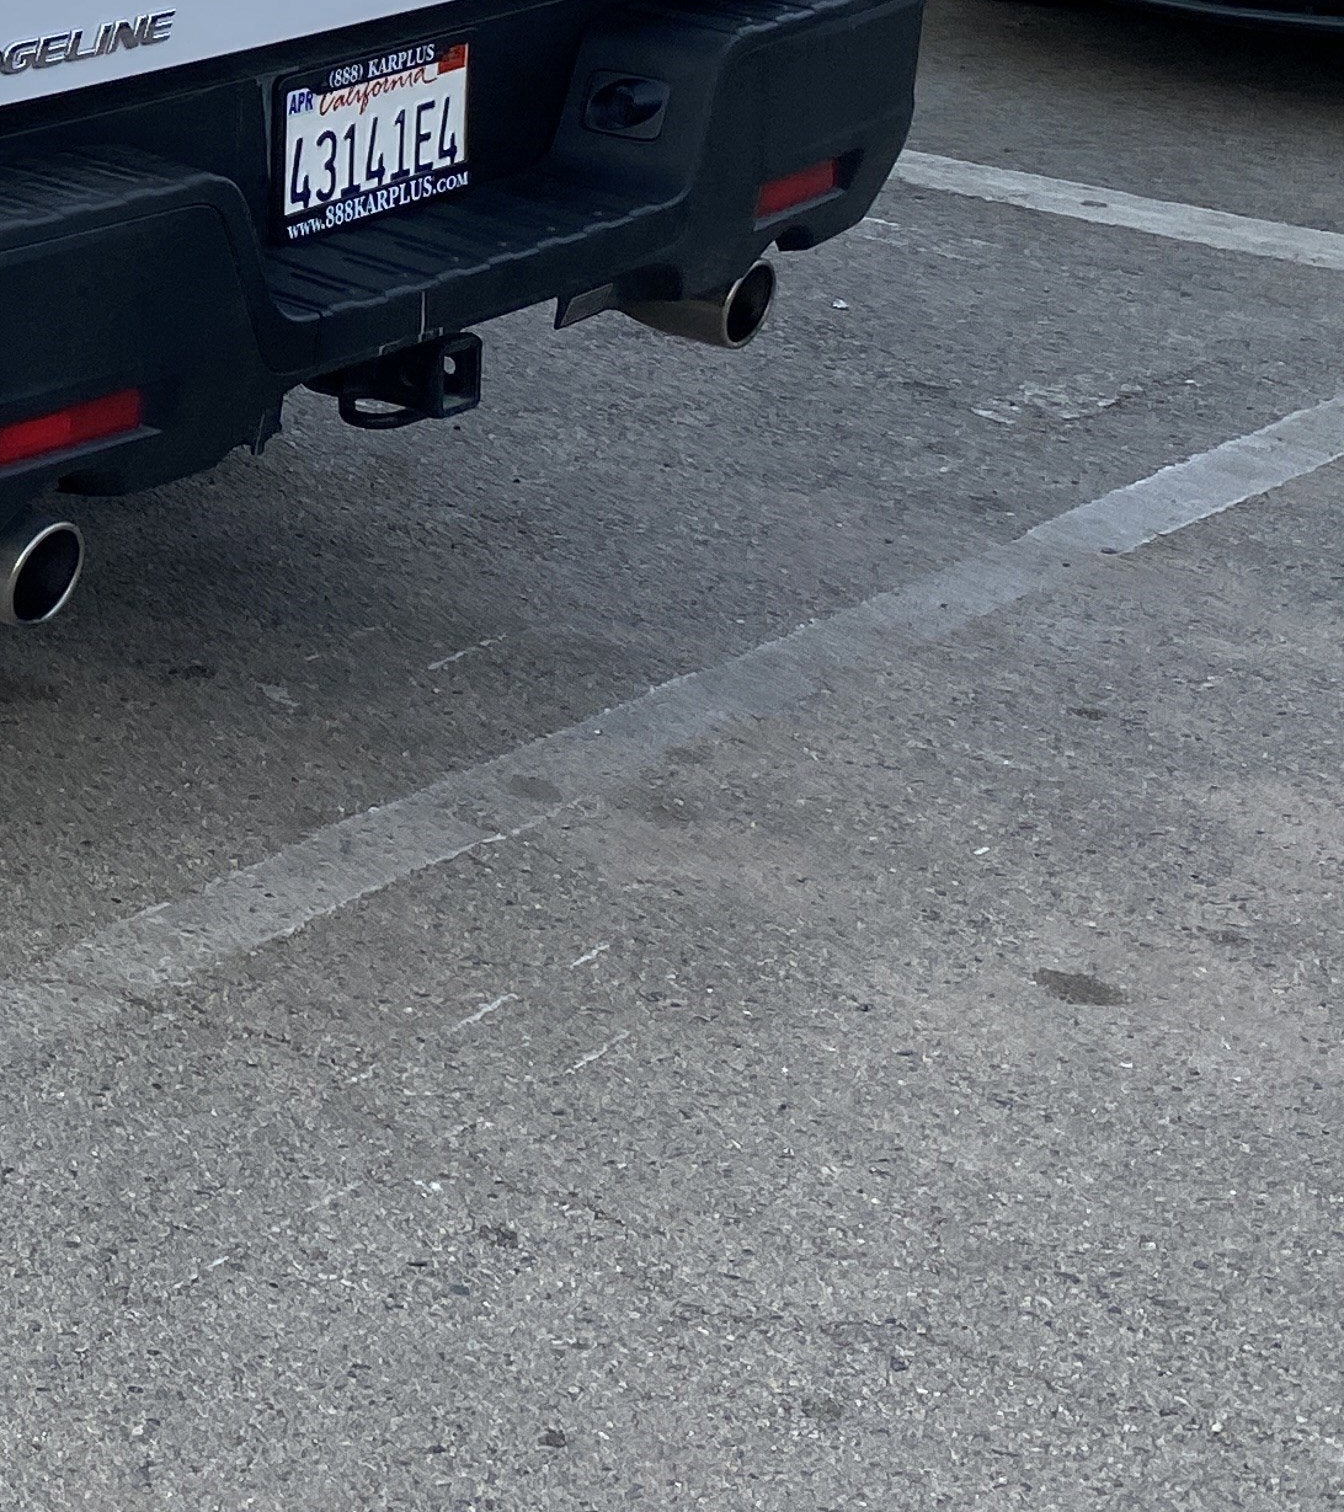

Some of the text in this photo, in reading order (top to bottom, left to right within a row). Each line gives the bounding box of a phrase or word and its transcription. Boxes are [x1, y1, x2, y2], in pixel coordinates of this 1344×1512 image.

[328, 63, 364, 88] (888)
[366, 43, 436, 78] KARPLUS
[288, 90, 314, 116] APR
[319, 67, 438, 116] California
[289, 96, 458, 210] 43141E4
